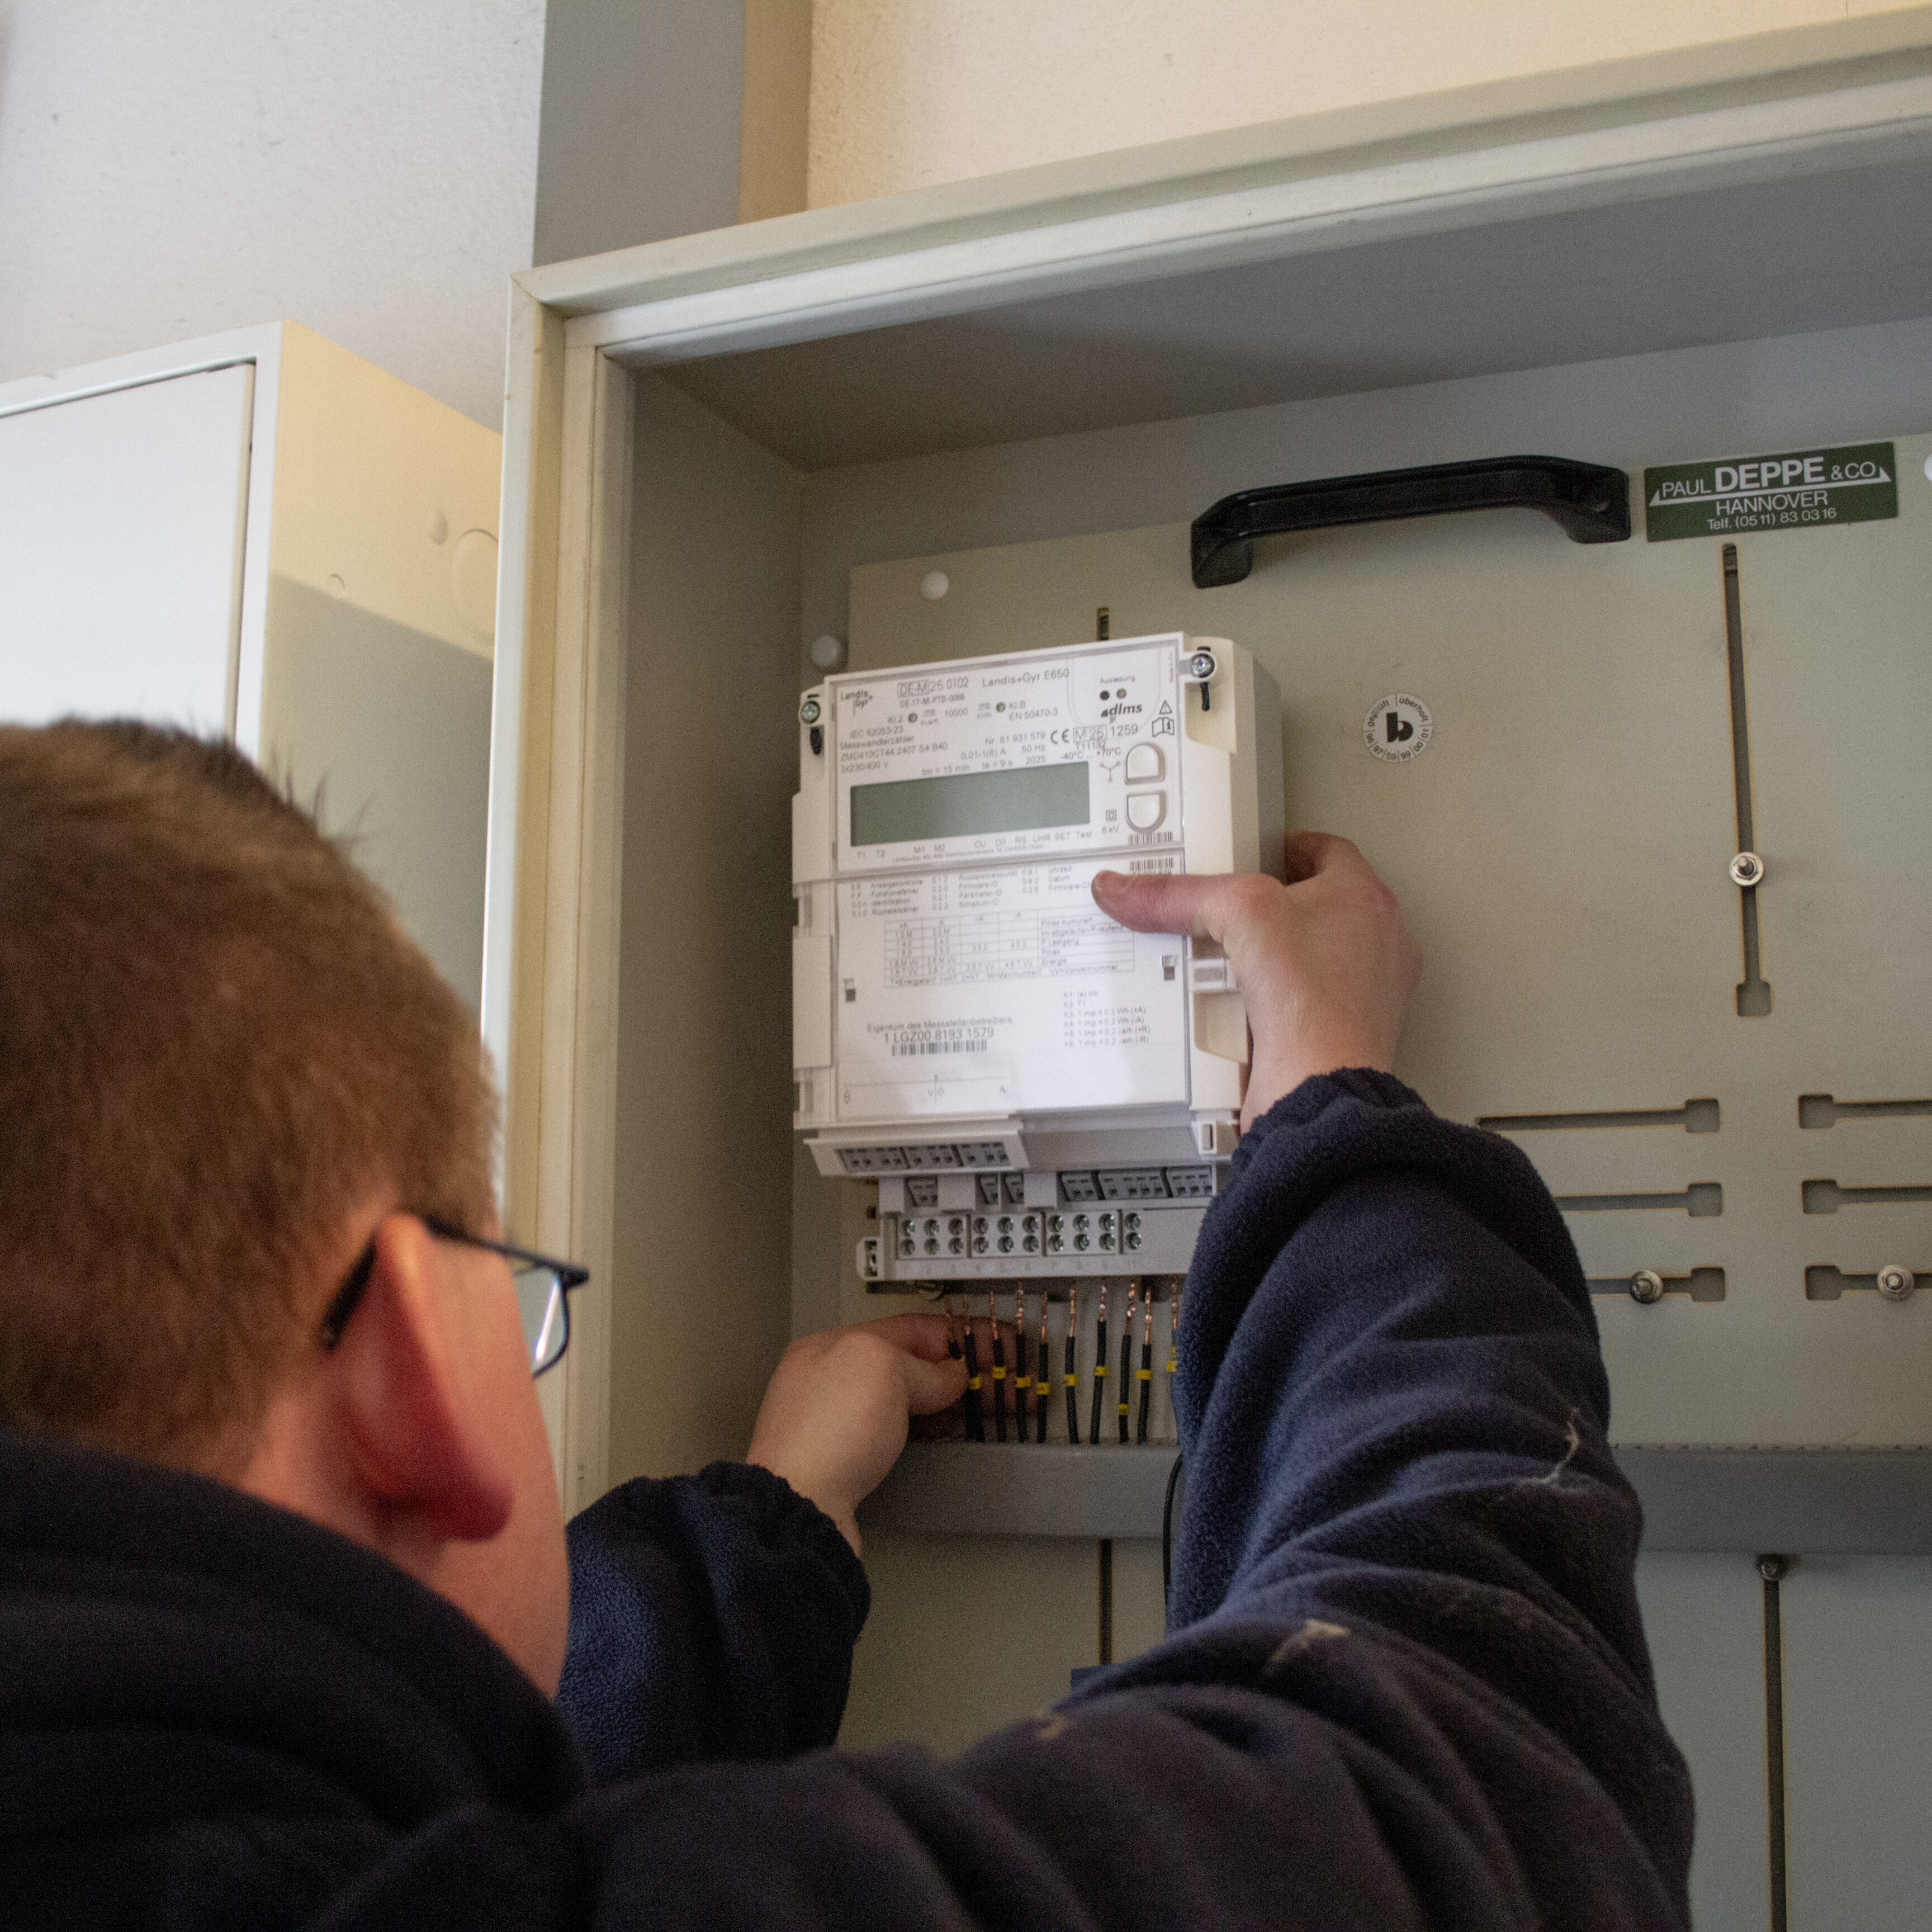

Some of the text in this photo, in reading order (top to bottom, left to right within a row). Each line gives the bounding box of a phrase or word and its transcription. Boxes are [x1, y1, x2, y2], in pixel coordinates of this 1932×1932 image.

[1662, 456, 1877, 498] PAUL DEPPE & CO
[1716, 490, 1829, 517] HANNOVER
[1707, 517, 1732, 531] Telf.
[946, 676, 969, 690] 0102
[982, 668, 1070, 688] Landis+Gyr E650
[1110, 703, 1143, 716] dlms
[1110, 723, 1138, 737] 1259
[935, 1028, 963, 1041] 8193
